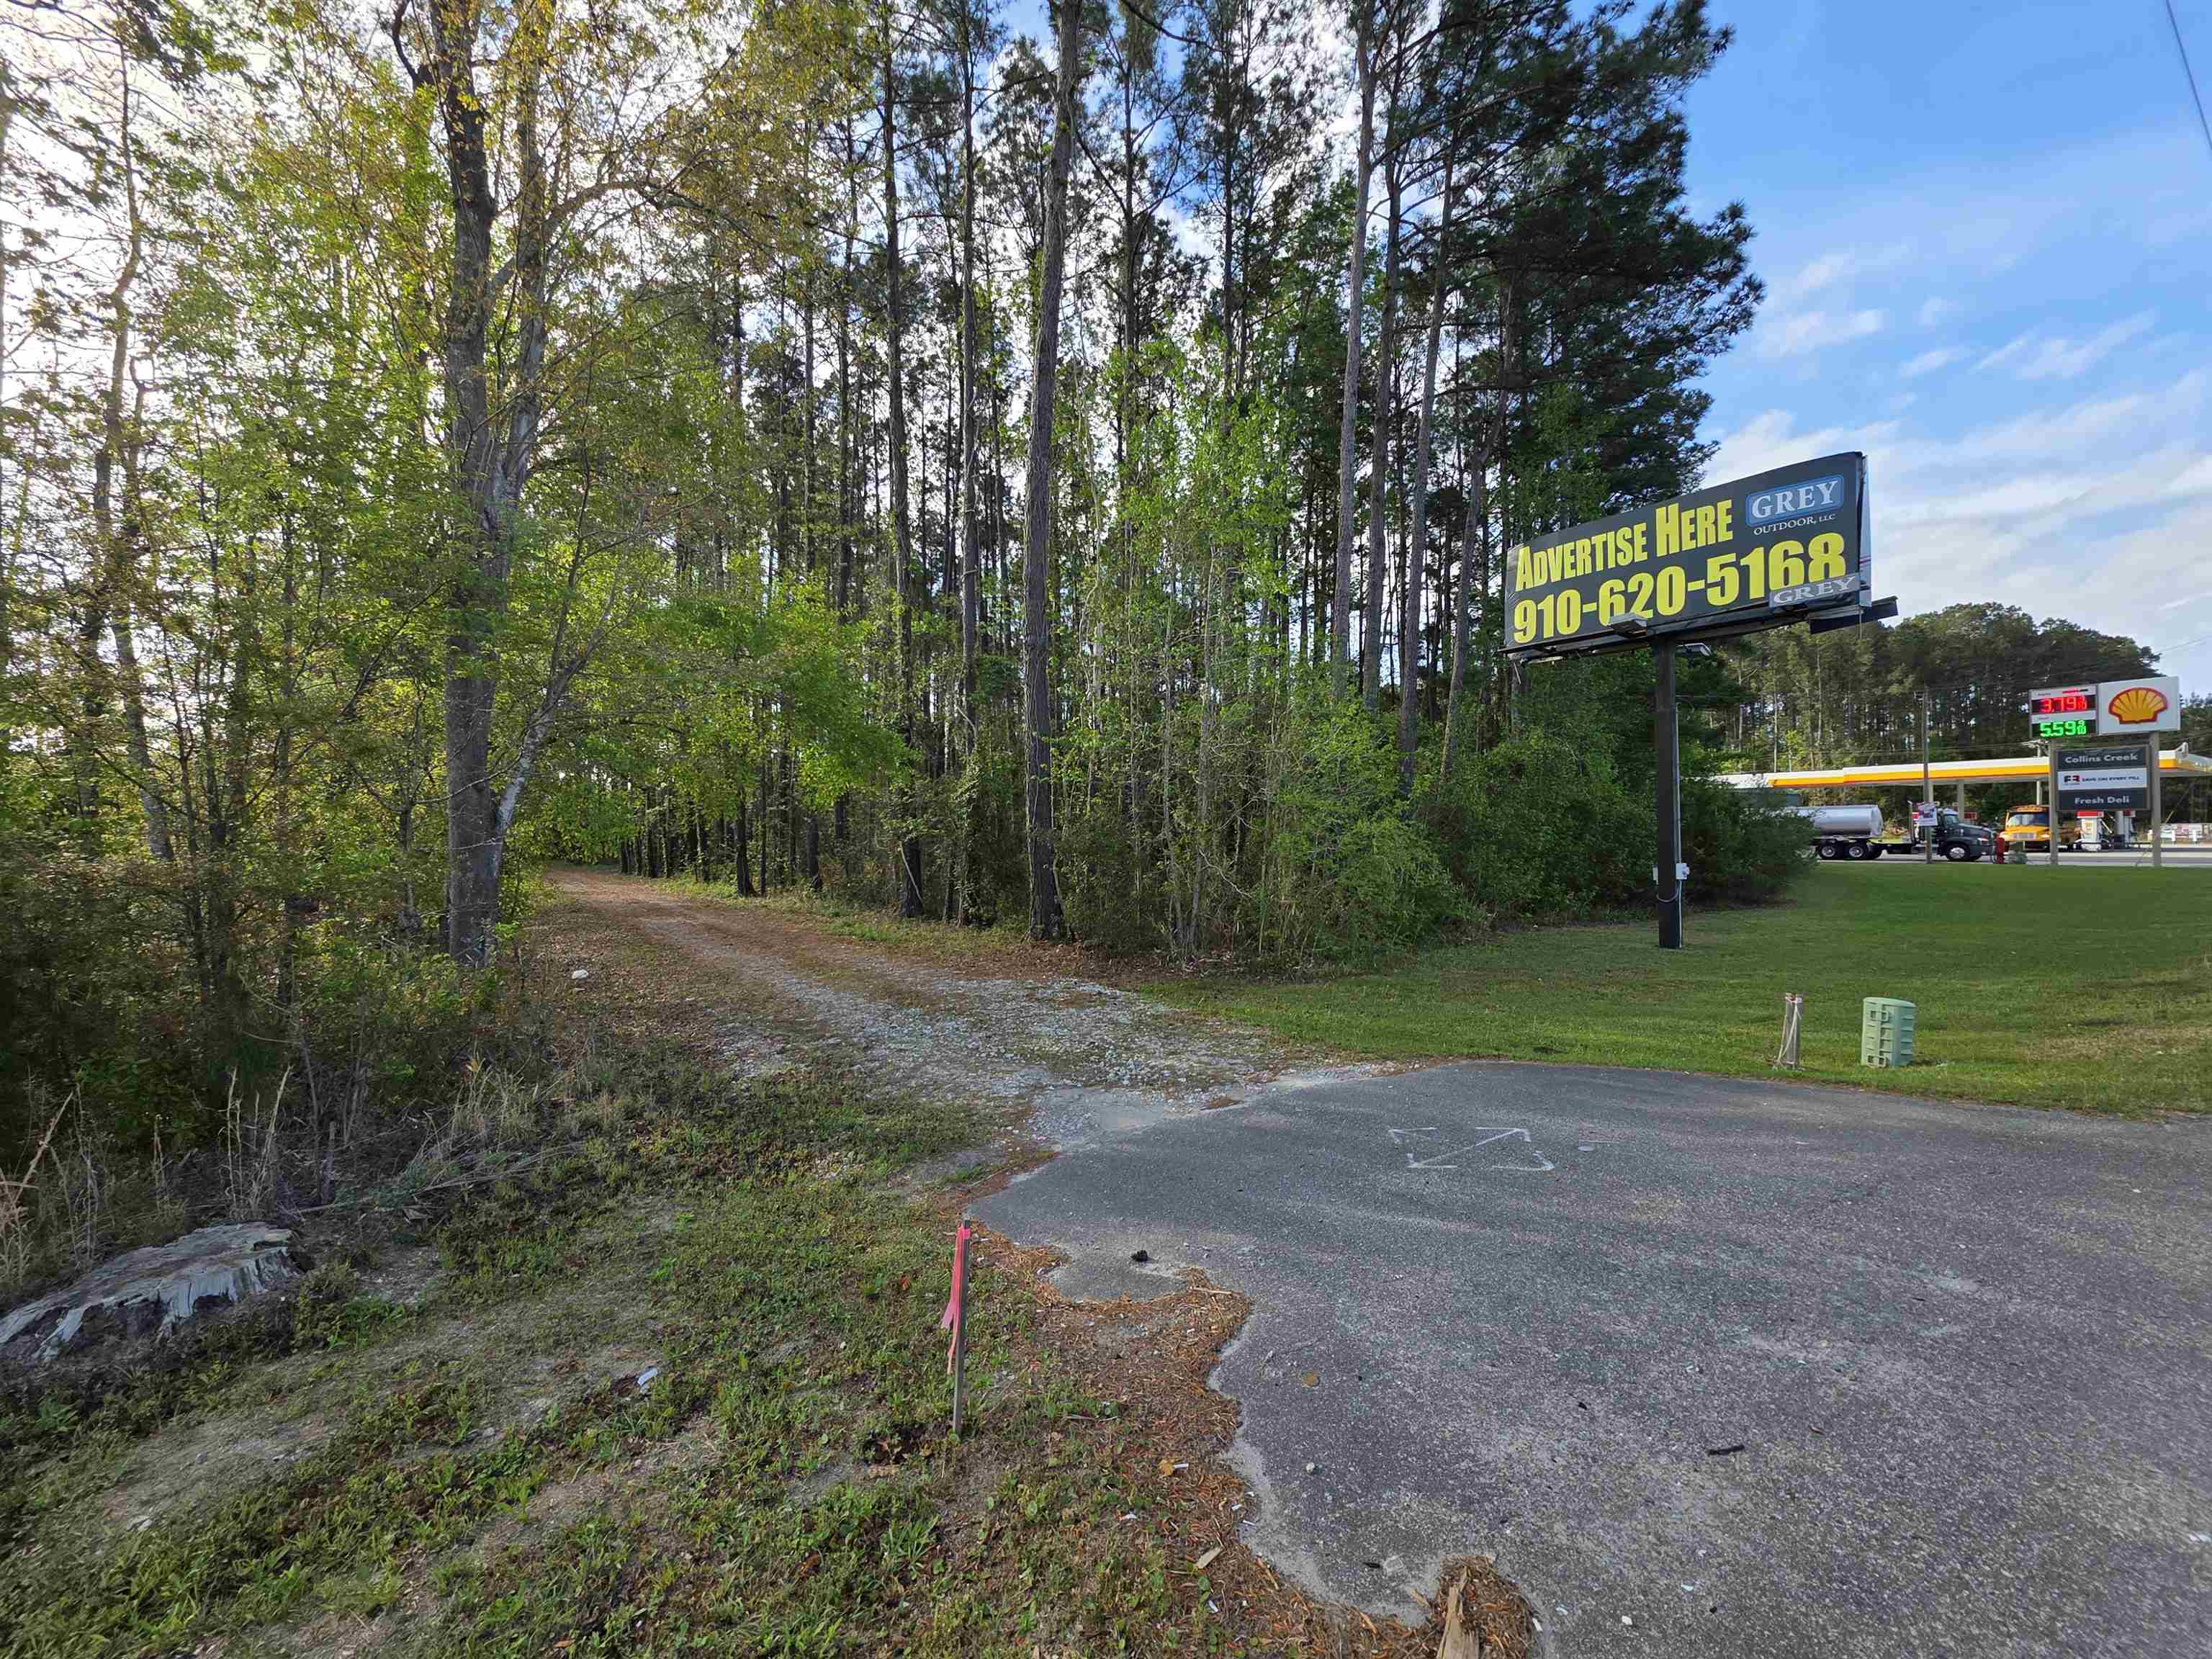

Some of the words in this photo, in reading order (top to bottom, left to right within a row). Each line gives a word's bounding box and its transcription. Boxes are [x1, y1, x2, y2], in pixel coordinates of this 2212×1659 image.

[1752, 481, 1838, 518] GREY
[1655, 500, 1733, 557] HERE
[1819, 513, 1836, 522] LLC
[1514, 533, 1846, 643] 910-620-5168
[1773, 576, 1856, 603] GREY
[2065, 755, 2102, 763] Collins
[2104, 753, 2138, 762] Creek
[2074, 796, 2104, 804] Fresh
[2107, 795, 2130, 804] Deli
